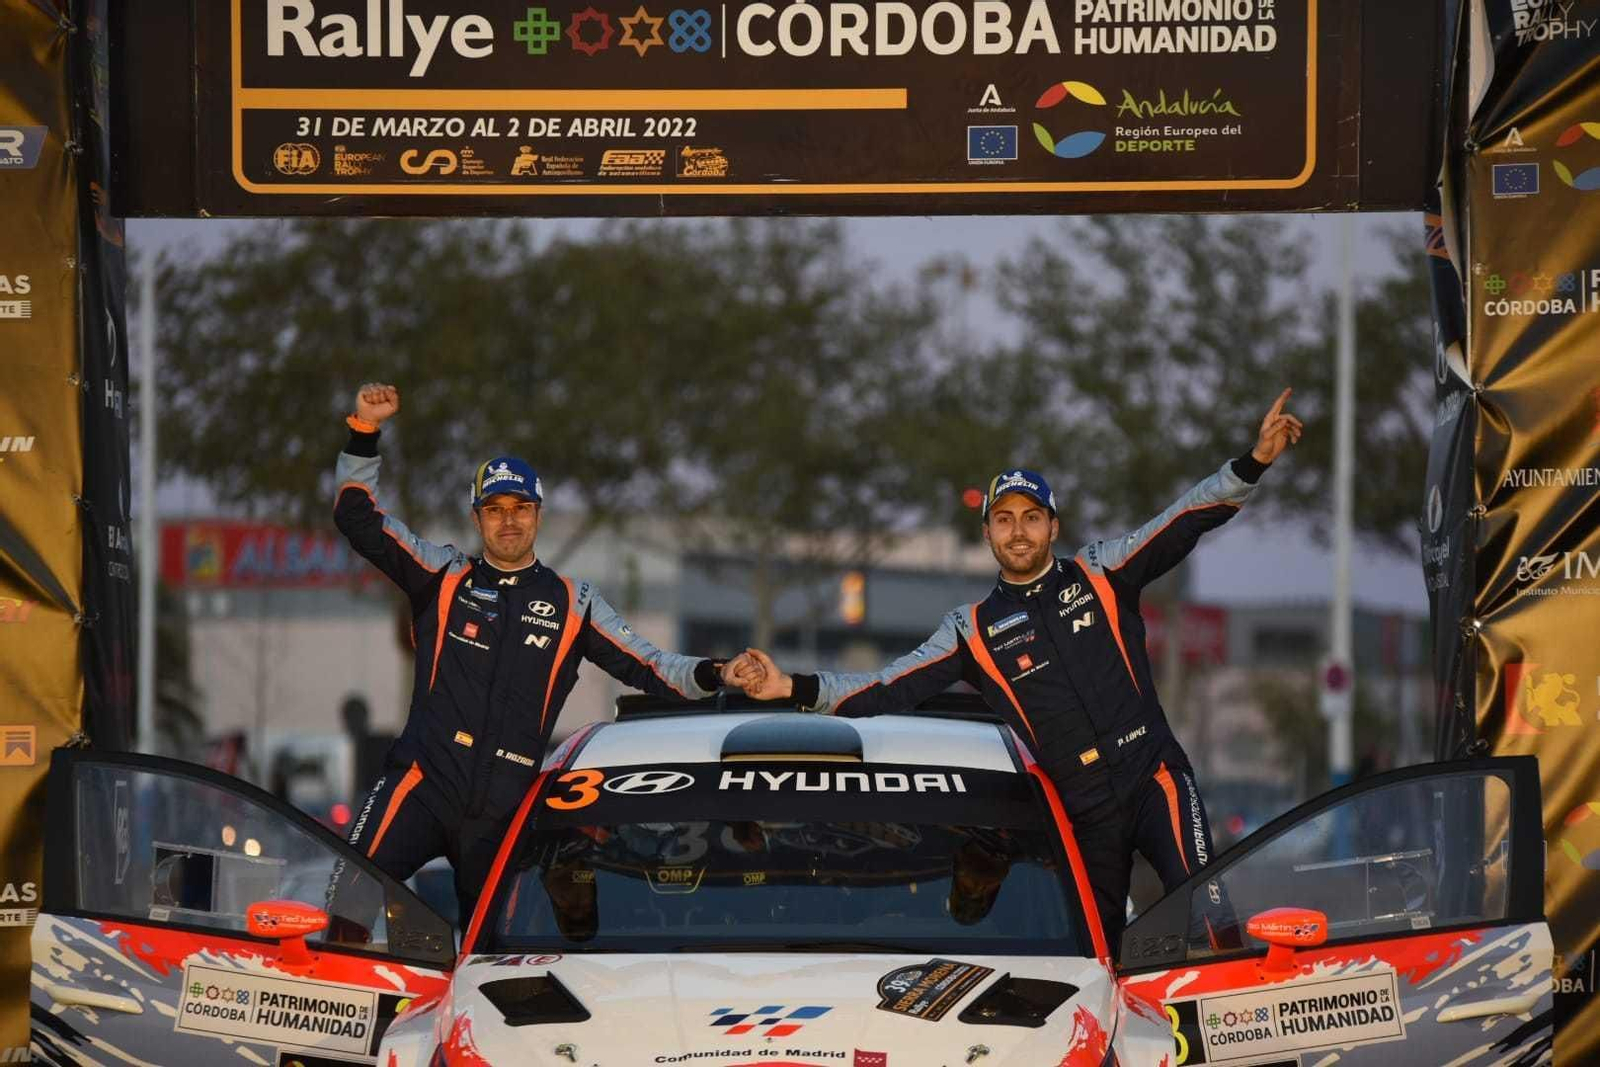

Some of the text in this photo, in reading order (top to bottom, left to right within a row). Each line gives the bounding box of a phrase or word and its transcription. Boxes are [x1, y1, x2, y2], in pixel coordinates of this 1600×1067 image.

[1075, 0, 1253, 23] PATRIMONIO
[1258, 9, 1275, 20] LA
[267, 0, 494, 77] Rallye
[736, 0, 1061, 56] CÓRDOBA
[1516, 18, 1597, 47] TROPHY
[1074, 25, 1277, 55] HUMANIDAD
[1116, 88, 1242, 118] Andalucía
[297, 117, 697, 137] 31 DE MARZO AL 2 DE ABRIL 2022
[1115, 125, 1242, 138] Región Europea del
[1115, 140, 1195, 152] DEPORTE
[277, 150, 316, 169] FIA
[1484, 298, 1577, 317] CÓRDOBA
[1516, 588, 1558, 596] Instituto
[1059, 593, 1094, 617] HYUNDAI
[521, 615, 560, 630] HYUNDAI
[546, 770, 604, 810] 3
[719, 772, 966, 793] HYUNDAI
[658, 869, 693, 883] OMP
[743, 873, 766, 885] OMP
[186, 1000, 246, 1022] CÓRDOBA
[260, 991, 356, 1018] PATRIMONIO
[1279, 990, 1378, 1017] PATRIMONIO
[256, 1008, 366, 1039] HUMANIDAD
[1281, 1005, 1394, 1036] HUMANIDAD
[1210, 1024, 1273, 1046] CÓRDOBA
[655, 1048, 845, 1063] Comunidad de Madrid
